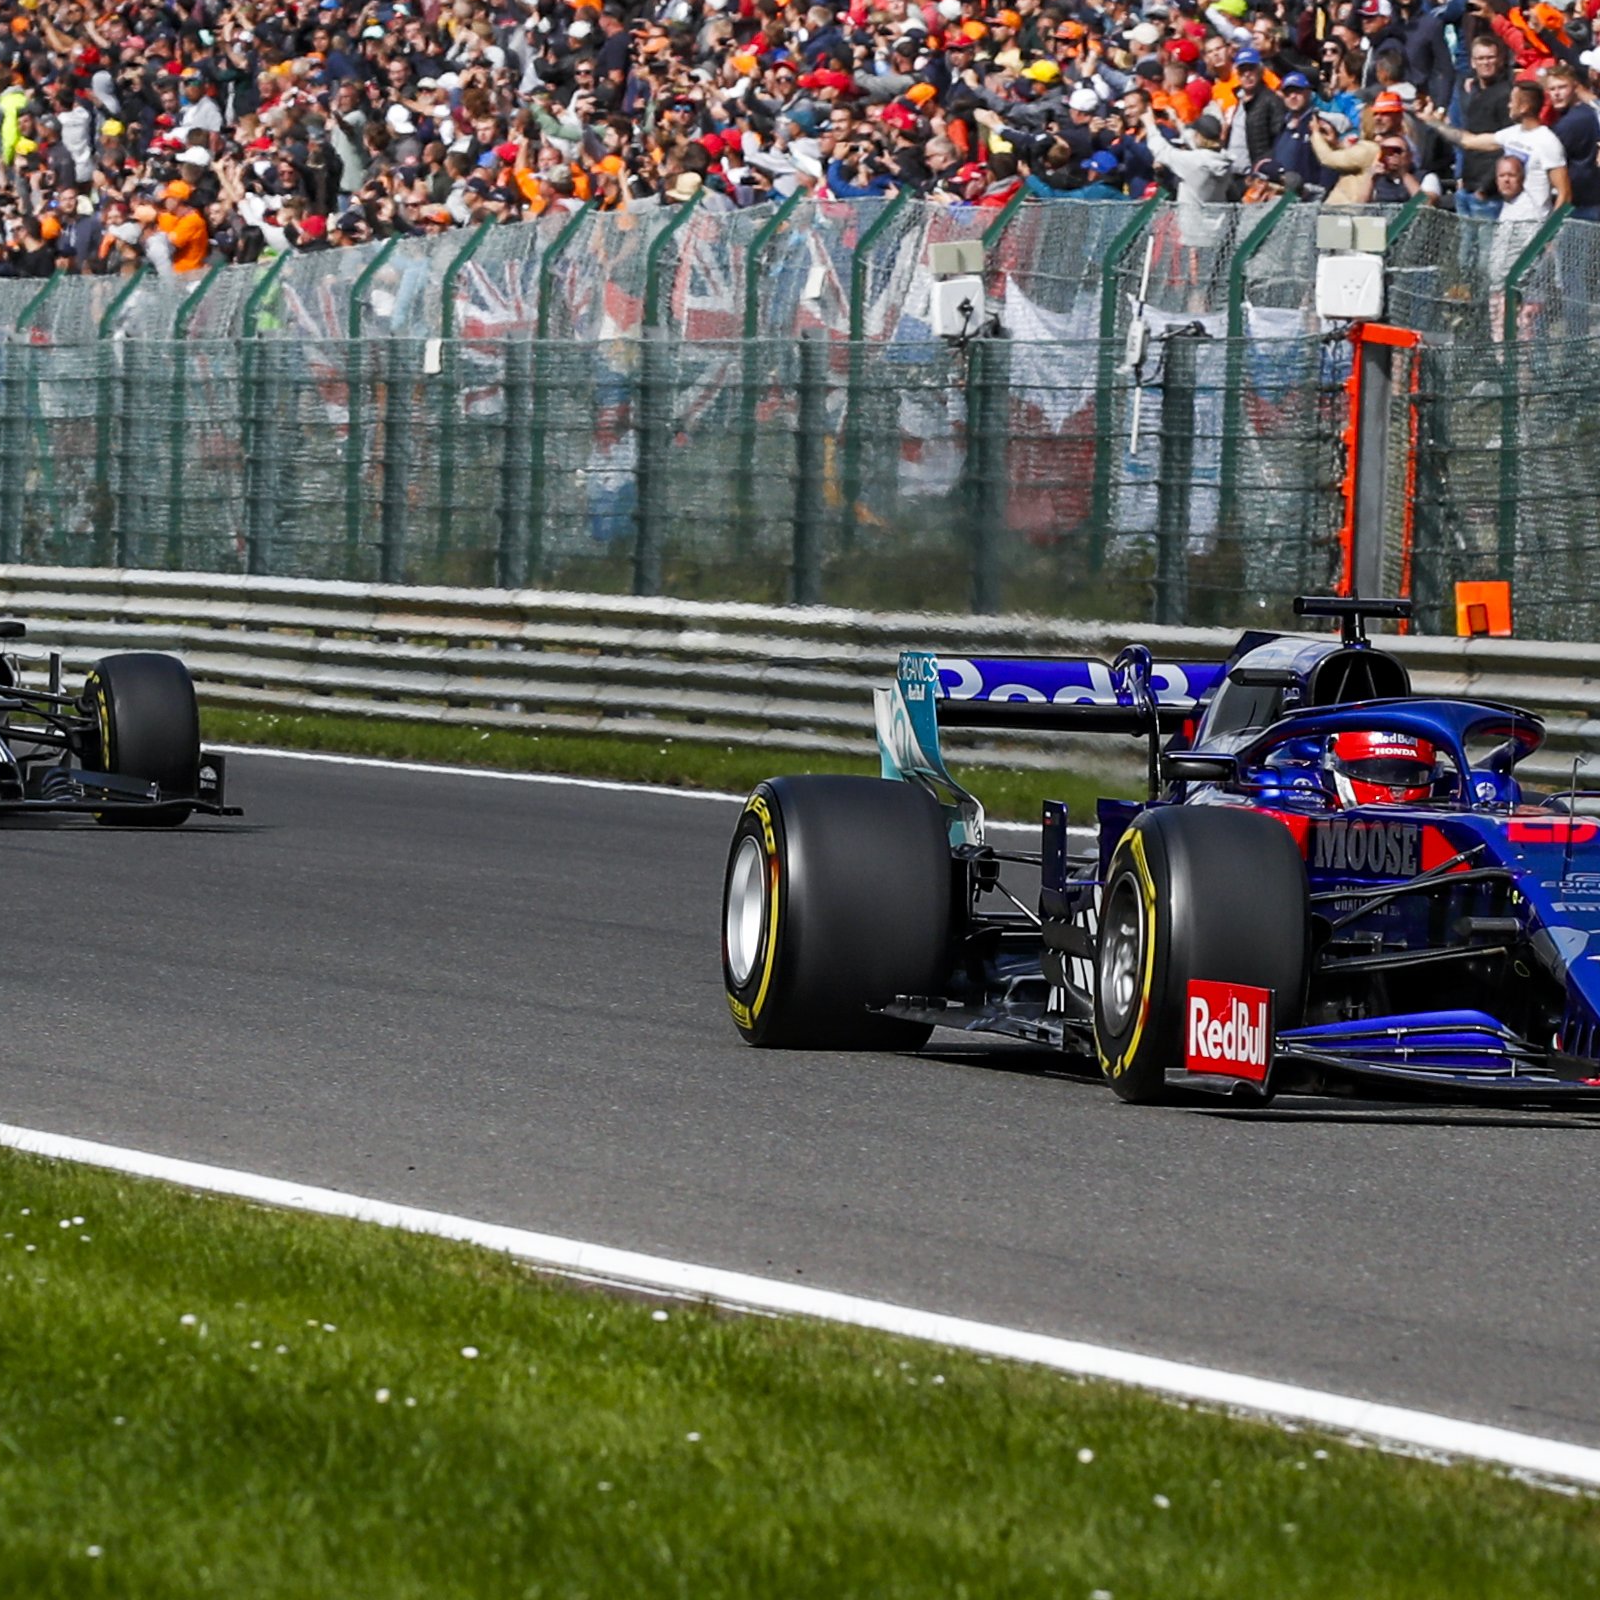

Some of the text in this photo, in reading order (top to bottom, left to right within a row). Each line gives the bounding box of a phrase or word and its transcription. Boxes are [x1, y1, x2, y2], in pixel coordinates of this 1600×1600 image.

[1375, 732, 1396, 744] Red
[1375, 748, 1417, 758] HONDA
[1314, 817, 1417, 877] MOOSE
